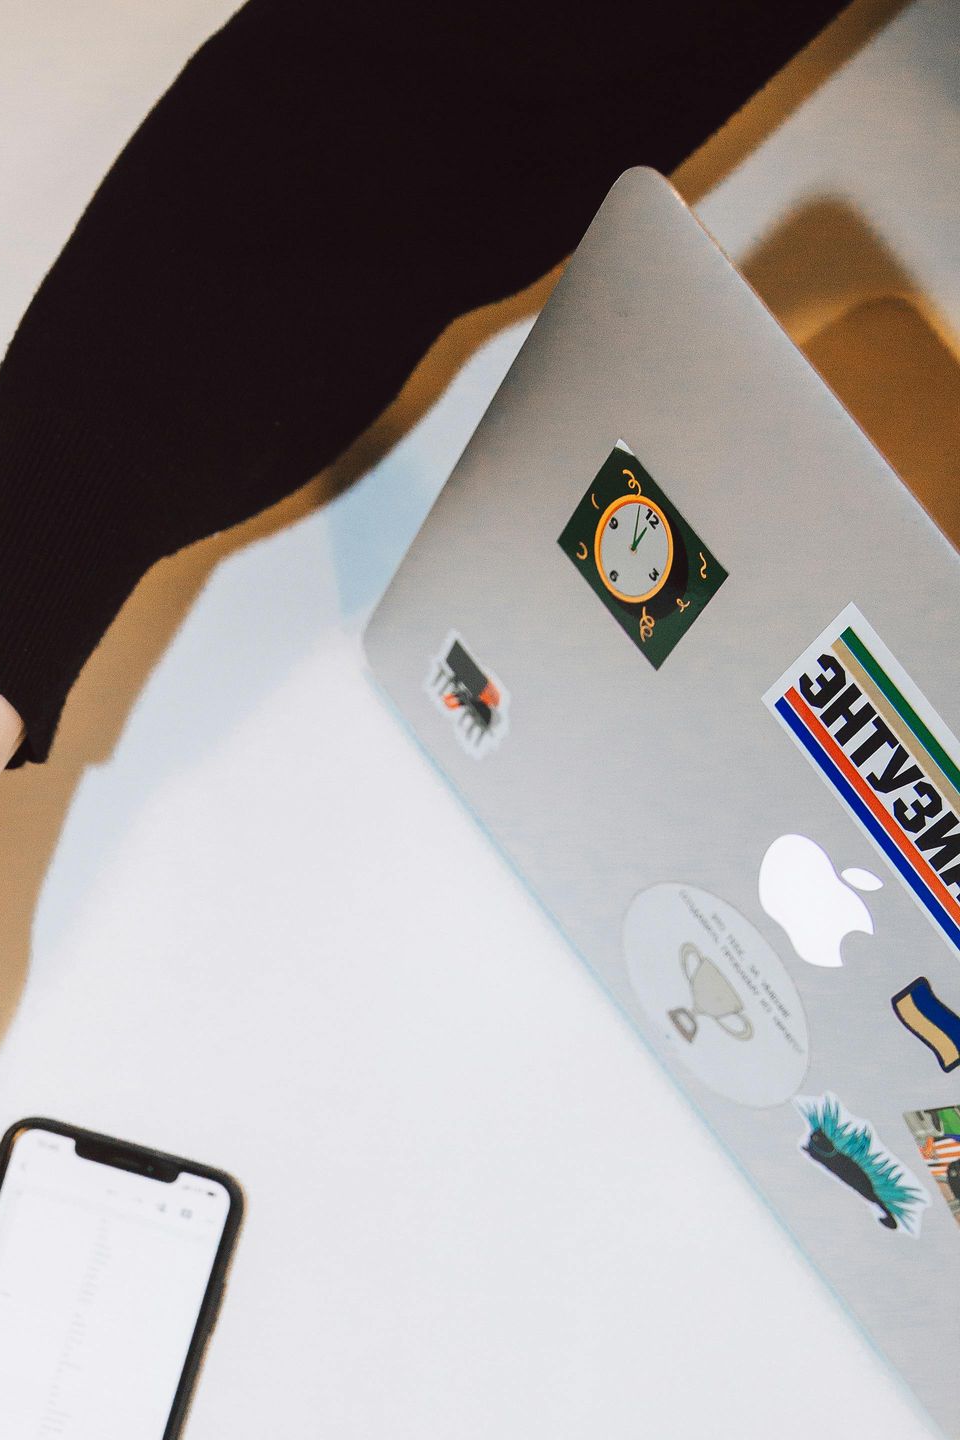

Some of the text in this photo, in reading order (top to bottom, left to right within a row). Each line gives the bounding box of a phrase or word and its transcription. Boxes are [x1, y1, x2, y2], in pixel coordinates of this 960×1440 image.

[609, 517, 619, 530] 9
[645, 508, 660, 530] 12
[609, 570, 619, 583] 6
[648, 568, 660, 582] 3
